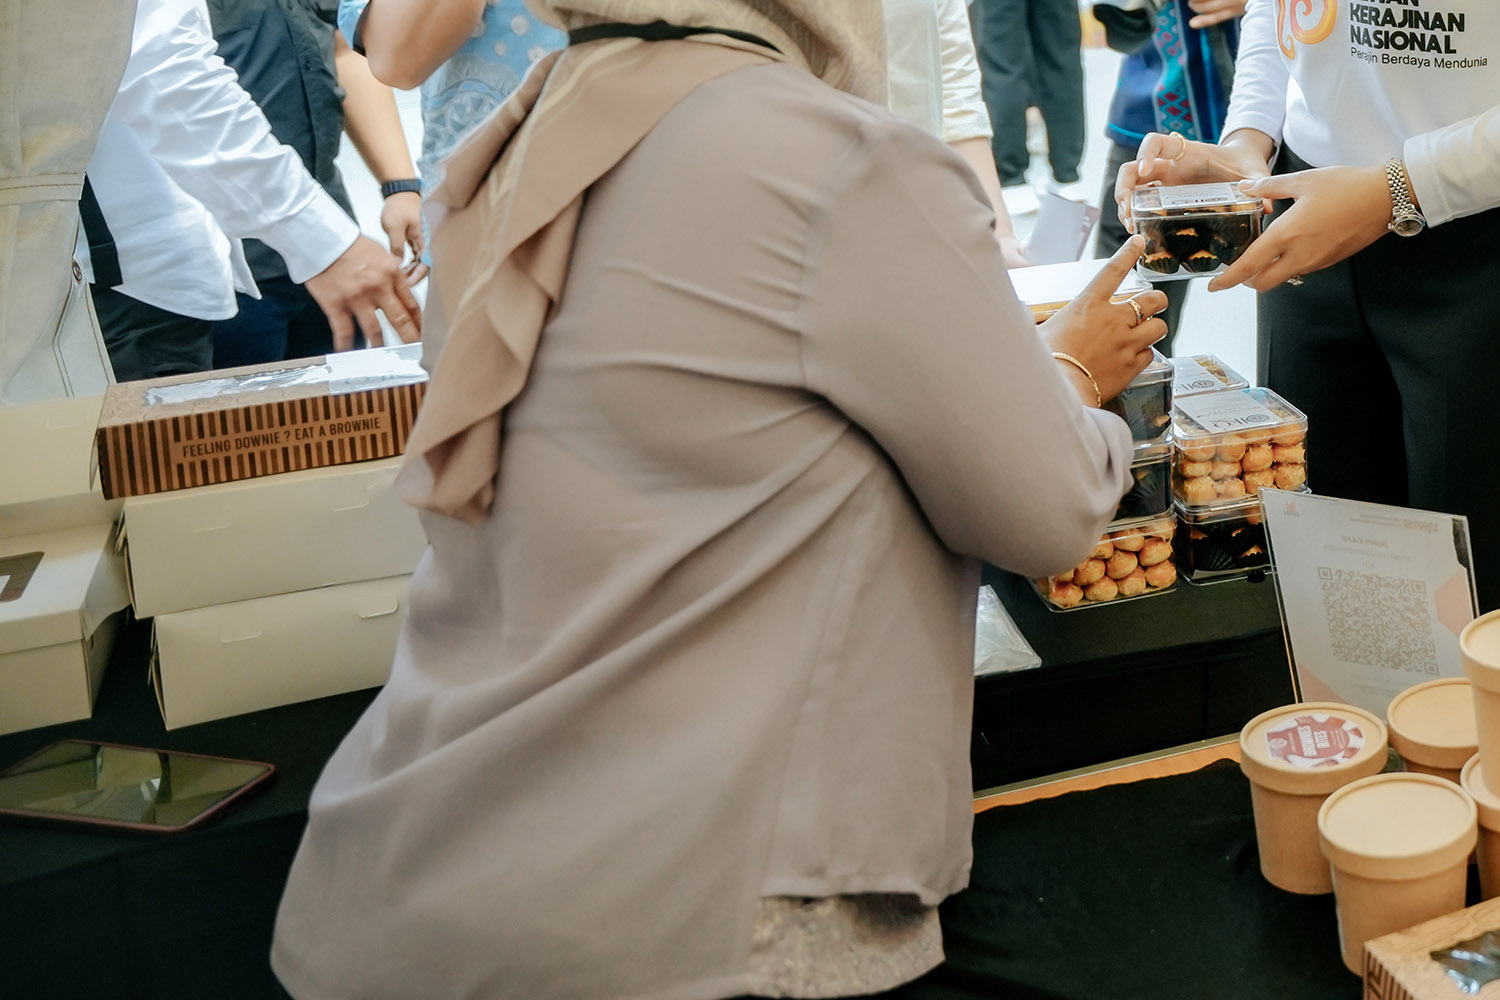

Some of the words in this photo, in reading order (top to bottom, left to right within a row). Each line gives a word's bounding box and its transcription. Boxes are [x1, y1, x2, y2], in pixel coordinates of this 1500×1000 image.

[1350, 2, 1465, 32] KERAJINAN
[1351, 24, 1457, 54] NASIONAL
[1351, 47, 1378, 64] Perajin
[1382, 54, 1430, 68] Berdaya
[1434, 57, 1488, 68] Mendunia
[183, 440, 231, 458] FEELING
[235, 433, 280, 450] DOWNIE
[295, 426, 315, 441] EAT
[319, 425, 326, 437] A
[330, 417, 380, 436] BROWNIE
